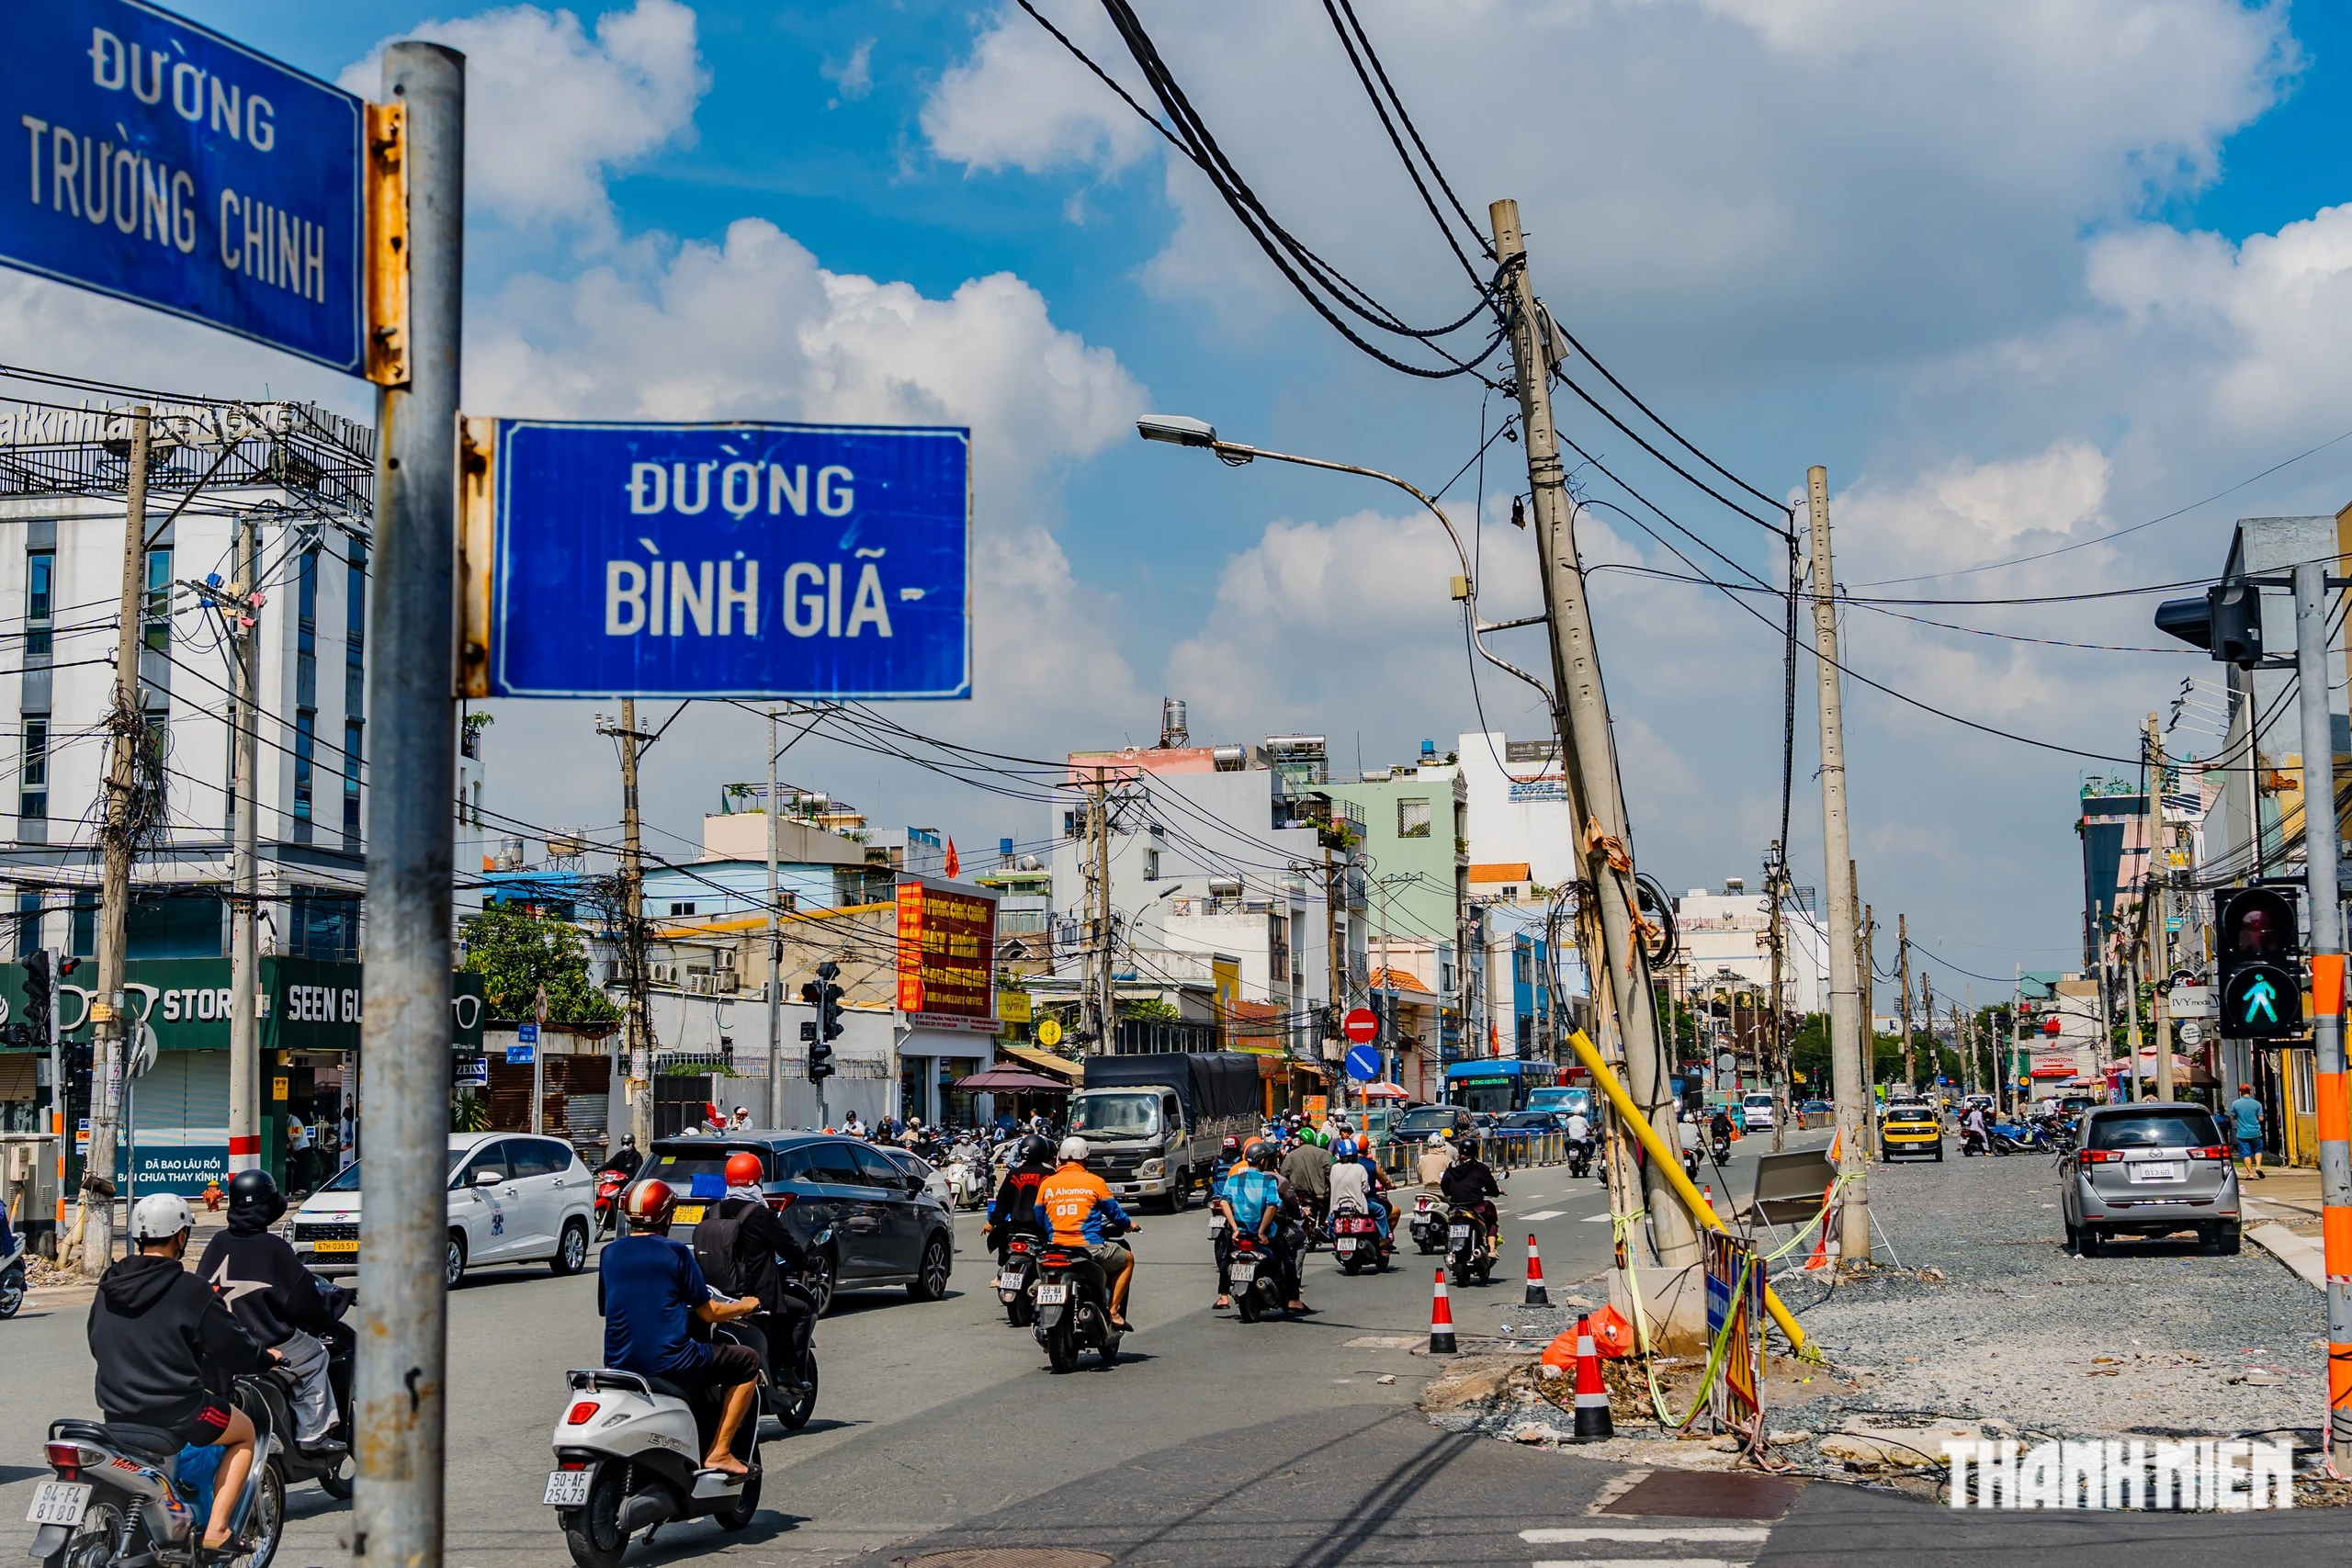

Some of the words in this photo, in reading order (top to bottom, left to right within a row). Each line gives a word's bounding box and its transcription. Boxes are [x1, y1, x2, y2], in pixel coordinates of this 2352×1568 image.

[87, 27, 275, 152] ĐƯỜNG
[22, 114, 196, 254] TRƯỜNG
[220, 188, 324, 304] CHINH
[625, 445, 854, 518] ĐƯỜNG
[605, 538, 759, 637] BÌNH
[783, 547, 893, 637] GIÃ
[288, 985, 336, 1022] SEEN
[943, 993, 966, 1005] NOTARY
[966, 996, 984, 1006] OFFICE
[2172, 998, 2190, 1008] IVY
[456, 1064, 485, 1075] ZEISS
[145, 1158, 160, 1169] ĐÃ
[161, 1160, 181, 1169] BAO
[183, 1157, 202, 1169] LÂU
[203, 1156, 220, 1169] RỒI
[139, 1172, 166, 1182] CHƯA
[167, 1172, 194, 1182] THAY
[195, 1170, 218, 1182] KÍNH
[1056, 1188, 1094, 1196] Ahamove
[647, 1432, 682, 1450] EVO
[553, 1472, 586, 1487] 50-AF
[42, 1484, 82, 1504] 94-F4
[547, 1488, 585, 1503] 254.73
[37, 1505, 77, 1522] 8180
